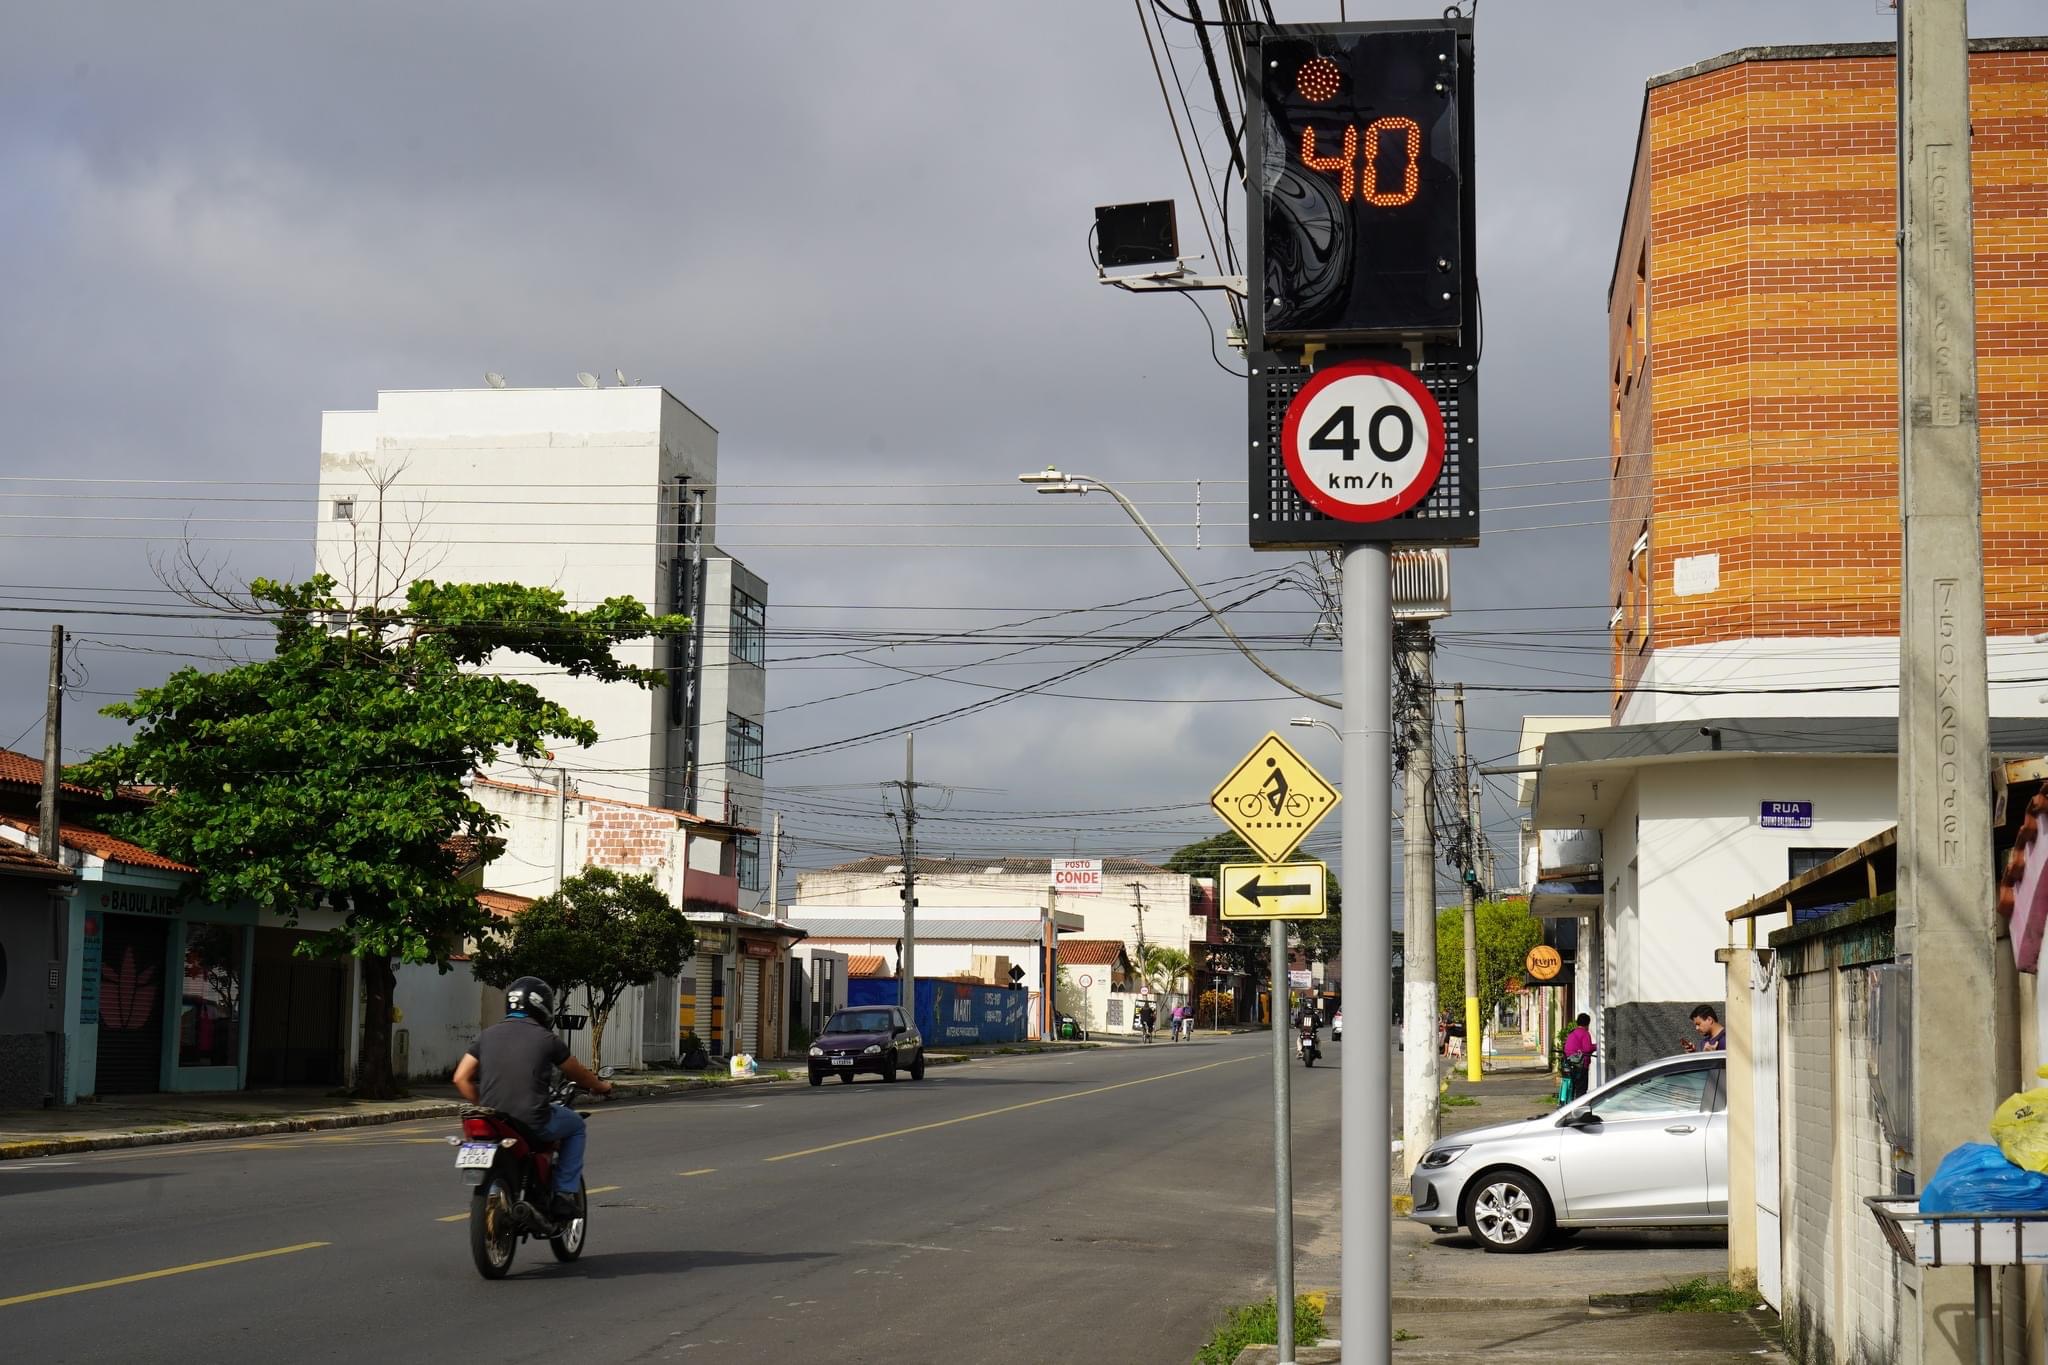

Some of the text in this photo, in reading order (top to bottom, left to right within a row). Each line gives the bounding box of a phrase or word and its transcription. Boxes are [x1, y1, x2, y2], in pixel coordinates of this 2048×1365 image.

[1301, 116, 1421, 207] 40
[1308, 404, 1415, 463] 40
[1328, 471, 1394, 490] km/h
[1772, 803, 1801, 814] RUA
[1065, 861, 1091, 869] POSTO
[1056, 871, 1099, 885] CONDE
